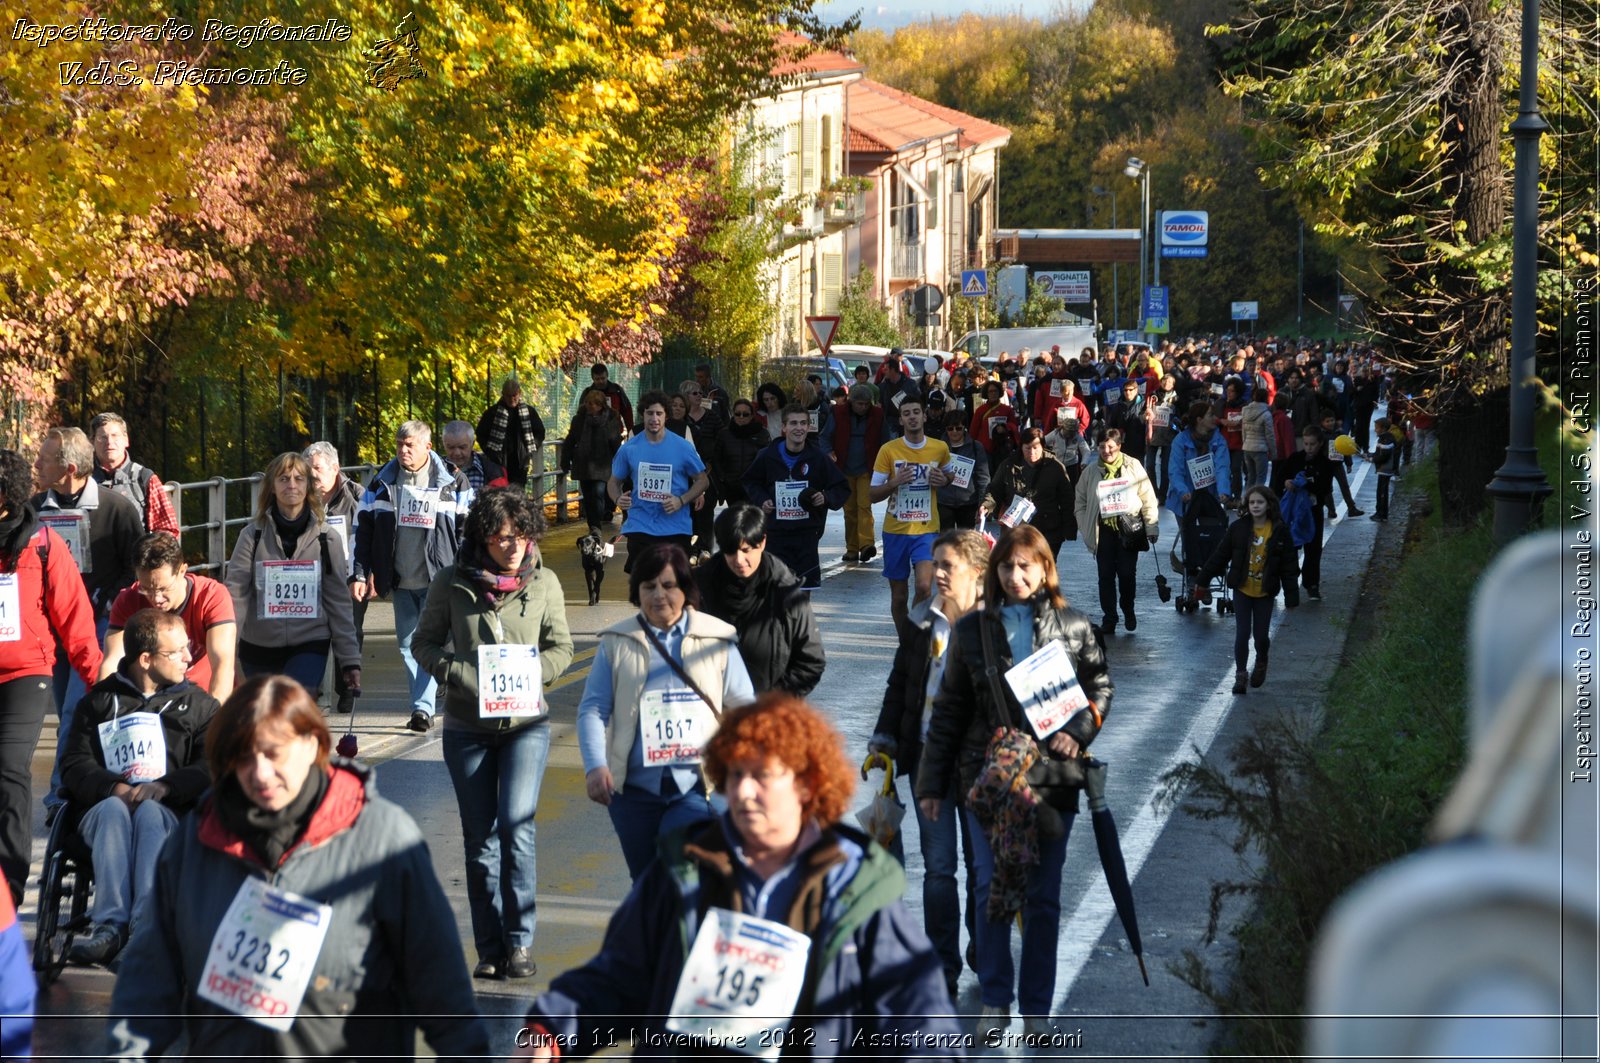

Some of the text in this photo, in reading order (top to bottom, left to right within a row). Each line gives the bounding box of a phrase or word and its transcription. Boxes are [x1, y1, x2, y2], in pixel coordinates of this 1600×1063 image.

[643, 477, 665, 490] 6387
[407, 499, 430, 513] 1670
[781, 496, 801, 508] 638
[905, 497, 924, 509] 1141
[401, 513, 433, 525] ipercoop
[275, 583, 307, 599] 8291
[268, 602, 314, 615] ipercoop
[491, 673, 530, 693] 13141
[1033, 674, 1069, 709] 1474
[655, 719, 692, 740] 1617
[226, 929, 290, 981] 3232
[207, 963, 288, 1015] ipercoop
[715, 964, 765, 1007] 195
